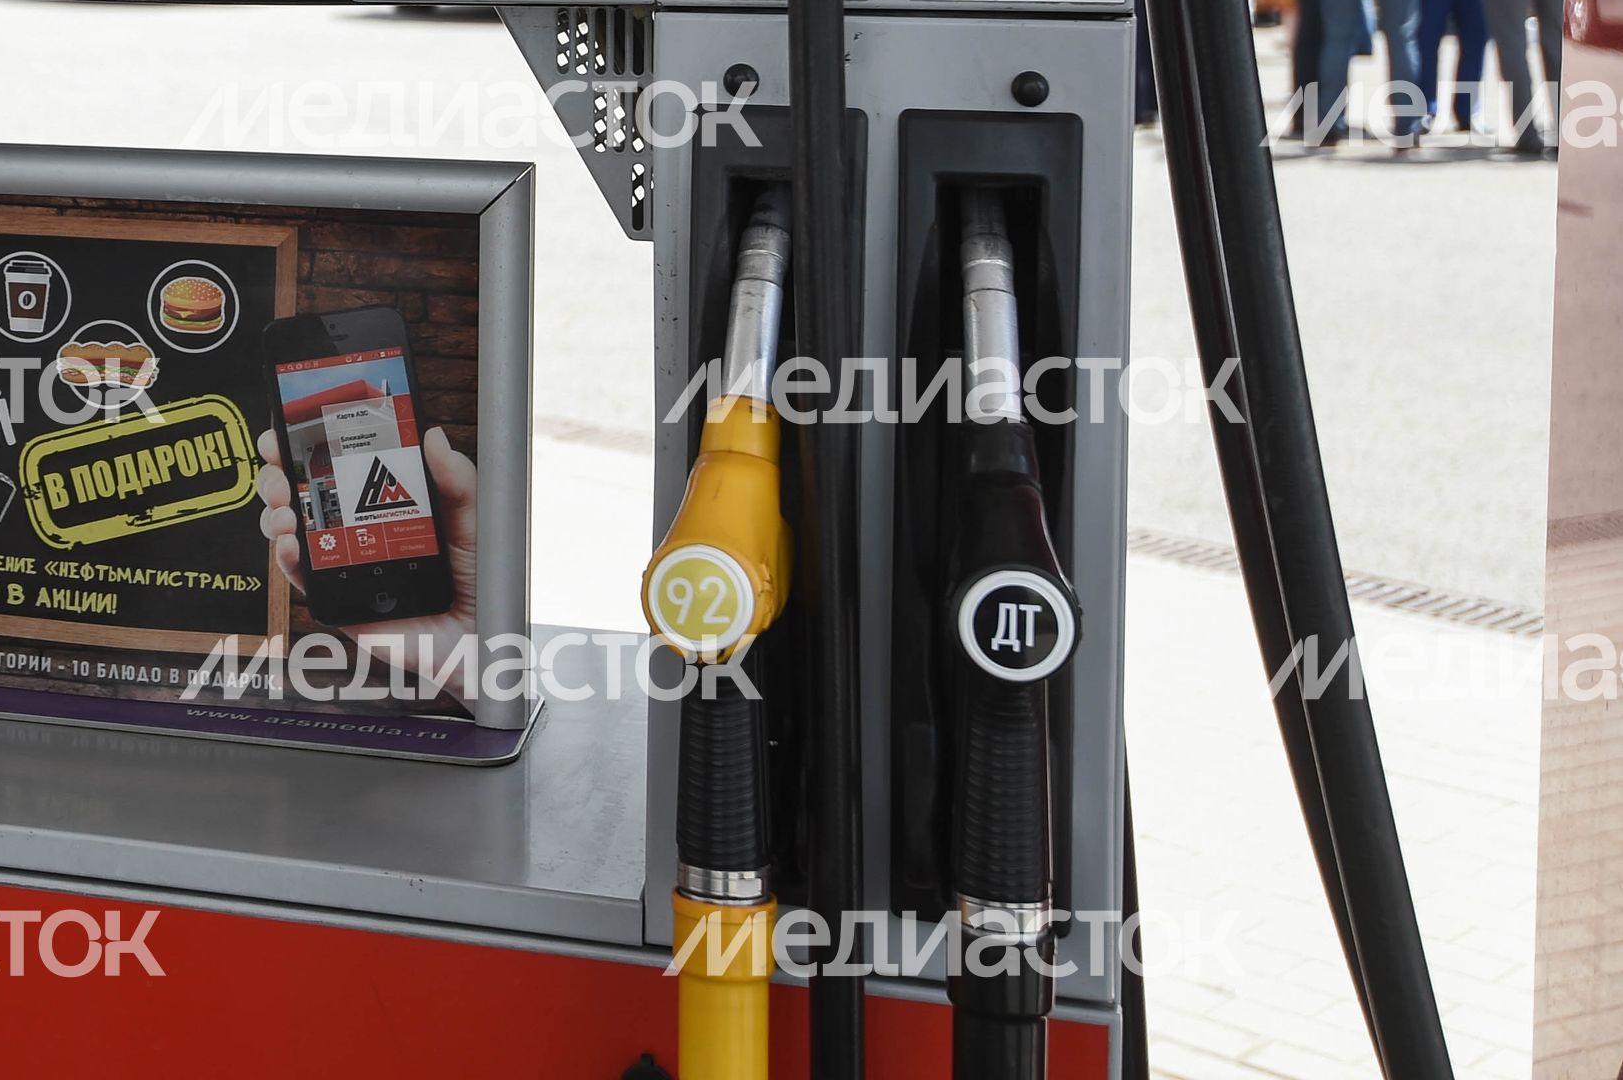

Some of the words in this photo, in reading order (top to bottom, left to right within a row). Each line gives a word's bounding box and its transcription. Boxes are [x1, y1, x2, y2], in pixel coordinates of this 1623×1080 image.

[336, 412, 355, 420] Карта
[43, 472, 70, 510] В
[70, 430, 232, 504] ПОДАРОК!
[354, 509, 421, 522] НЕФТЬМАГИСТРАЛЬ
[44, 560, 262, 593] «НЕФТЬМАГИСТРАЛЬ»
[6, 583, 26, 606] В
[35, 587, 118, 615] АКЦИИ!
[665, 574, 732, 626] 92
[990, 601, 1042, 653] ДТ
[72, 659, 89, 677] 10
[96, 661, 162, 684] БЛЮДО
[169, 668, 180, 684] В
[185, 707, 448, 741] www.azsmedia.ru
